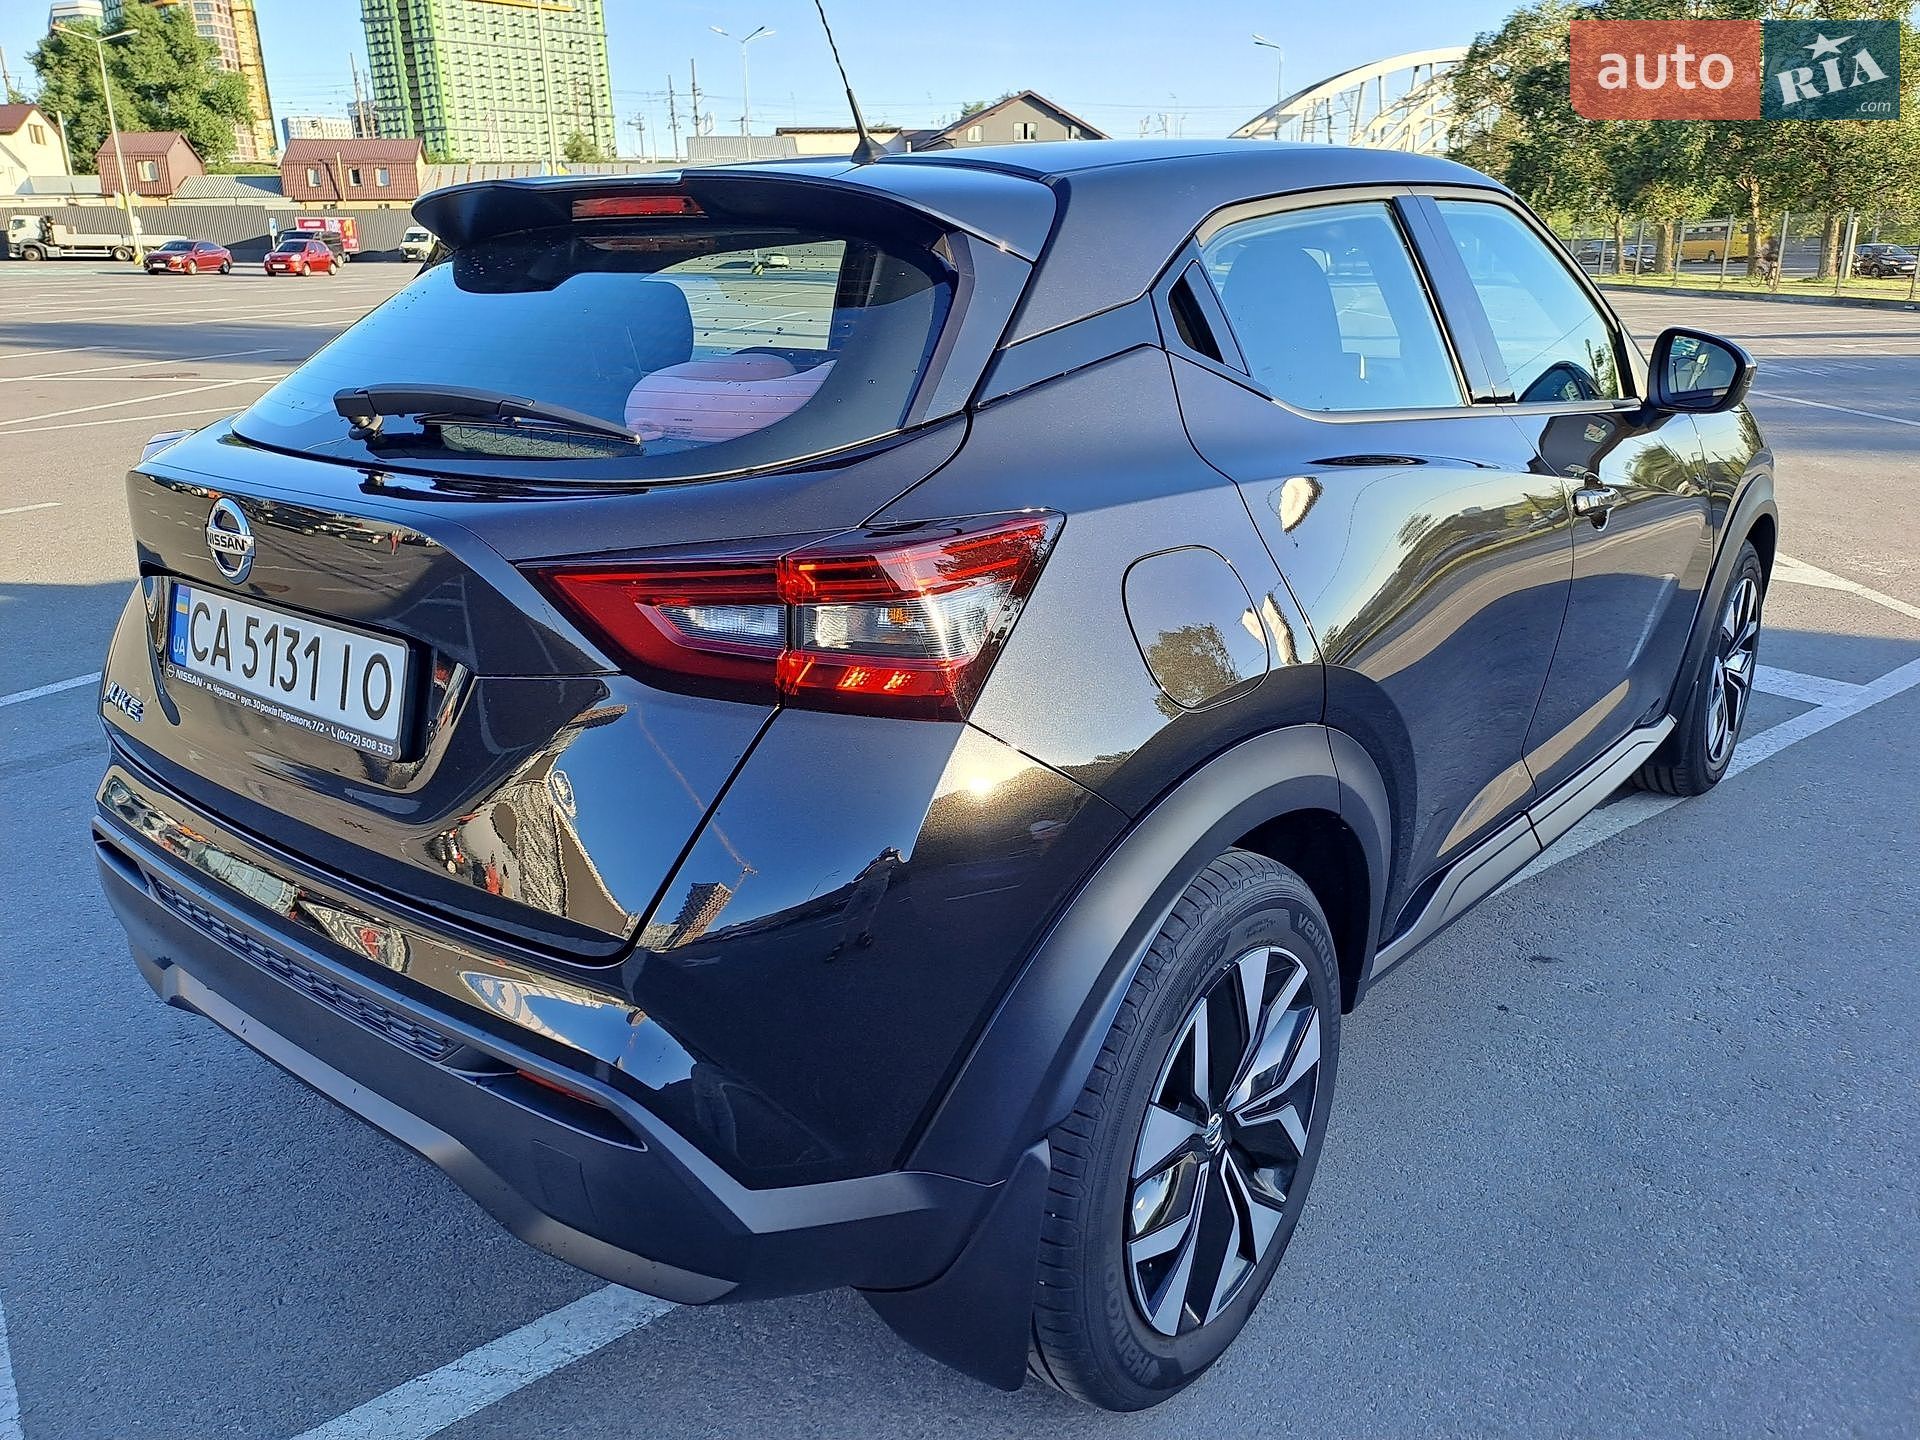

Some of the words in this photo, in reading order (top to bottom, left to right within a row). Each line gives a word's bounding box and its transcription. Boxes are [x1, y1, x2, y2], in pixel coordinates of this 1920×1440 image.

[207, 532, 245, 552] NISSAN
[173, 635, 186, 657] UA
[190, 602, 232, 672] CA
[242, 616, 320, 701] 5131
[340, 643, 394, 721] IO
[102, 681, 144, 723] JUKE
[175, 669, 203, 687] NISSAN
[337, 728, 361, 747] (0472)
[361, 737, 377, 751] 508
[378, 742, 394, 756] 333
